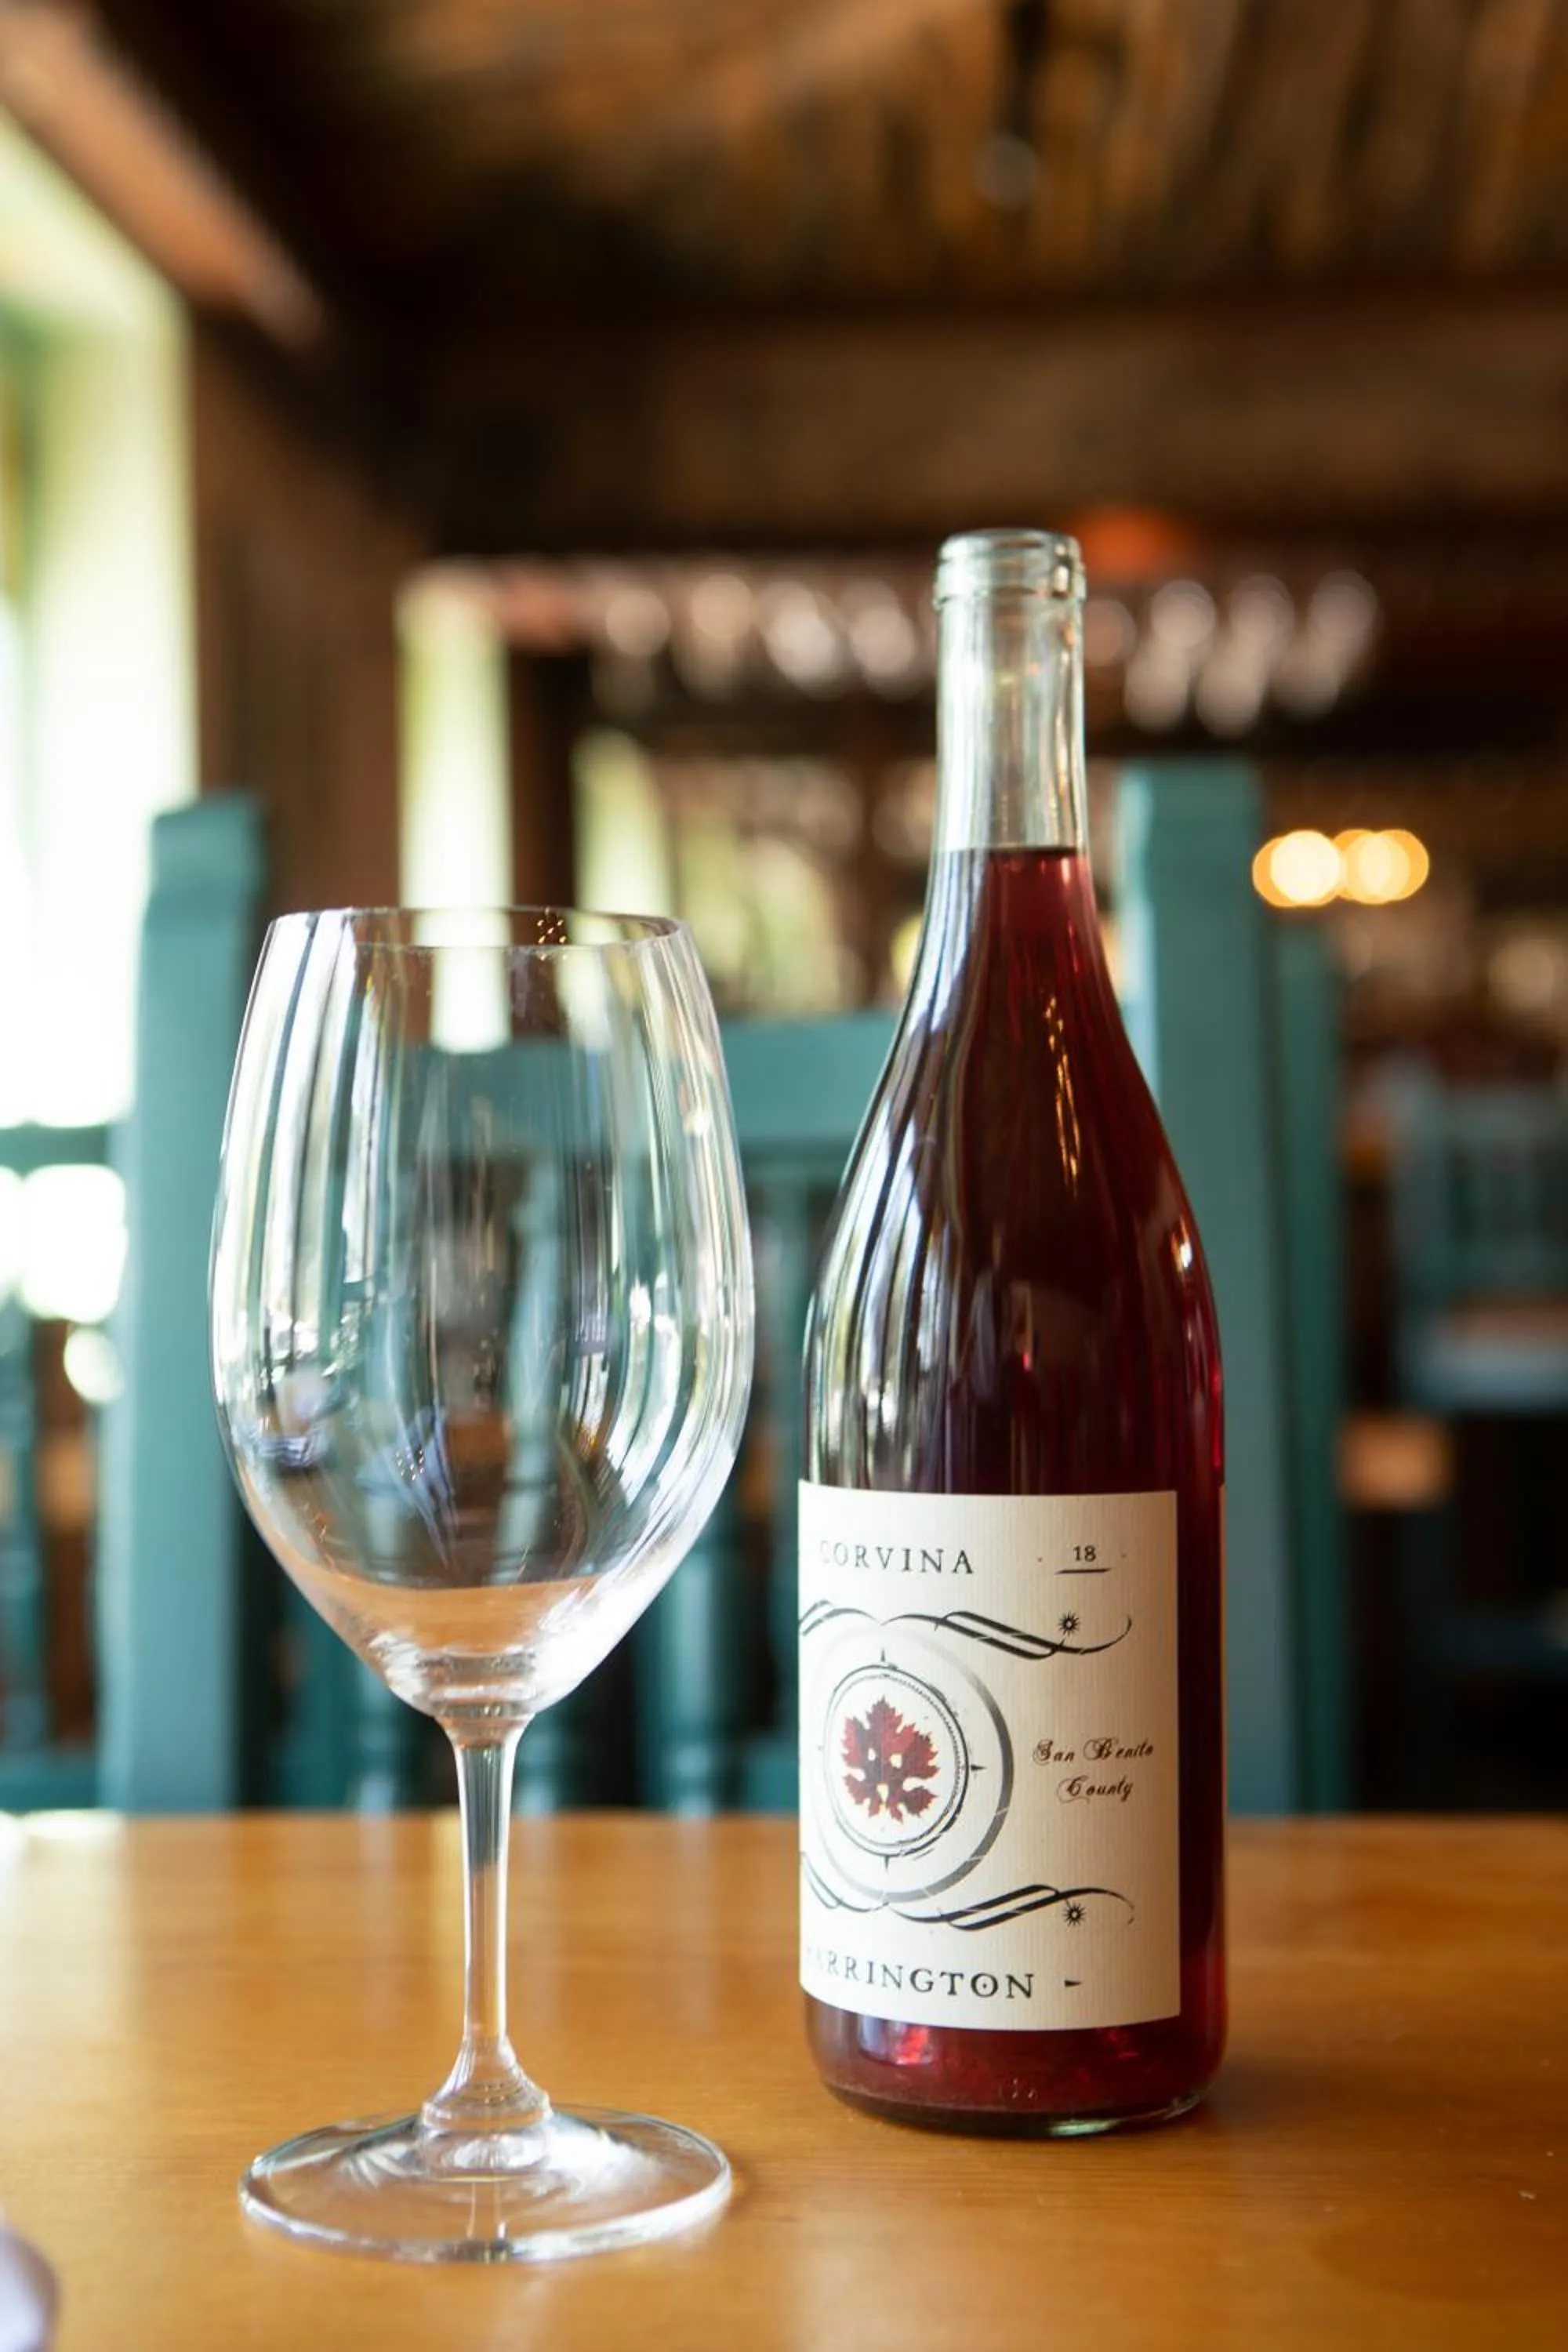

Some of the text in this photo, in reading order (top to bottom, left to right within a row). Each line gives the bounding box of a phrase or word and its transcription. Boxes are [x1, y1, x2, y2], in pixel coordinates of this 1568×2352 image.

[818, 1538, 973, 1574] CORVINA
[1073, 1544, 1097, 1562] 18
[1033, 1737, 1154, 1766] San Benito
[1057, 1774, 1134, 1804] County
